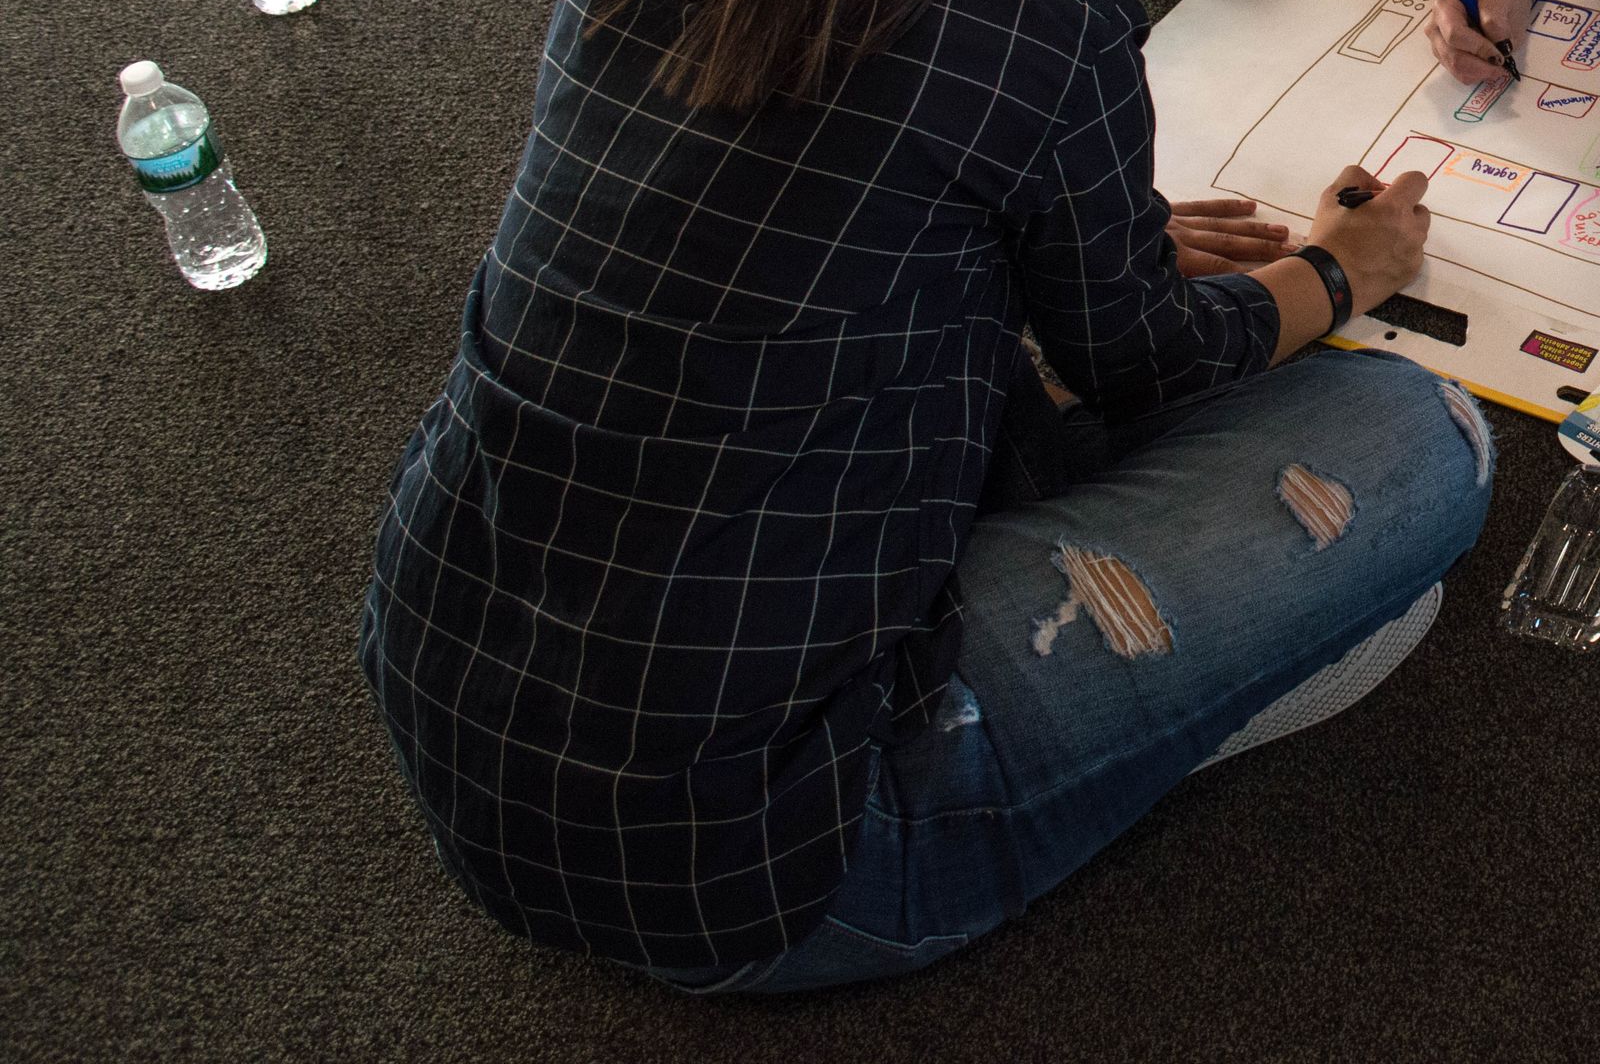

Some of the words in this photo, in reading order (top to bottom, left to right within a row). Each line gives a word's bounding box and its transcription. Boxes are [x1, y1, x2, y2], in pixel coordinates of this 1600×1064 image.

[1472, 158, 1518, 181] agency
[1540, 350, 1561, 362] Sticky
[1571, 346, 1592, 357] Super
[1567, 353, 1588, 363] Super
[1563, 359, 1584, 369] Super
